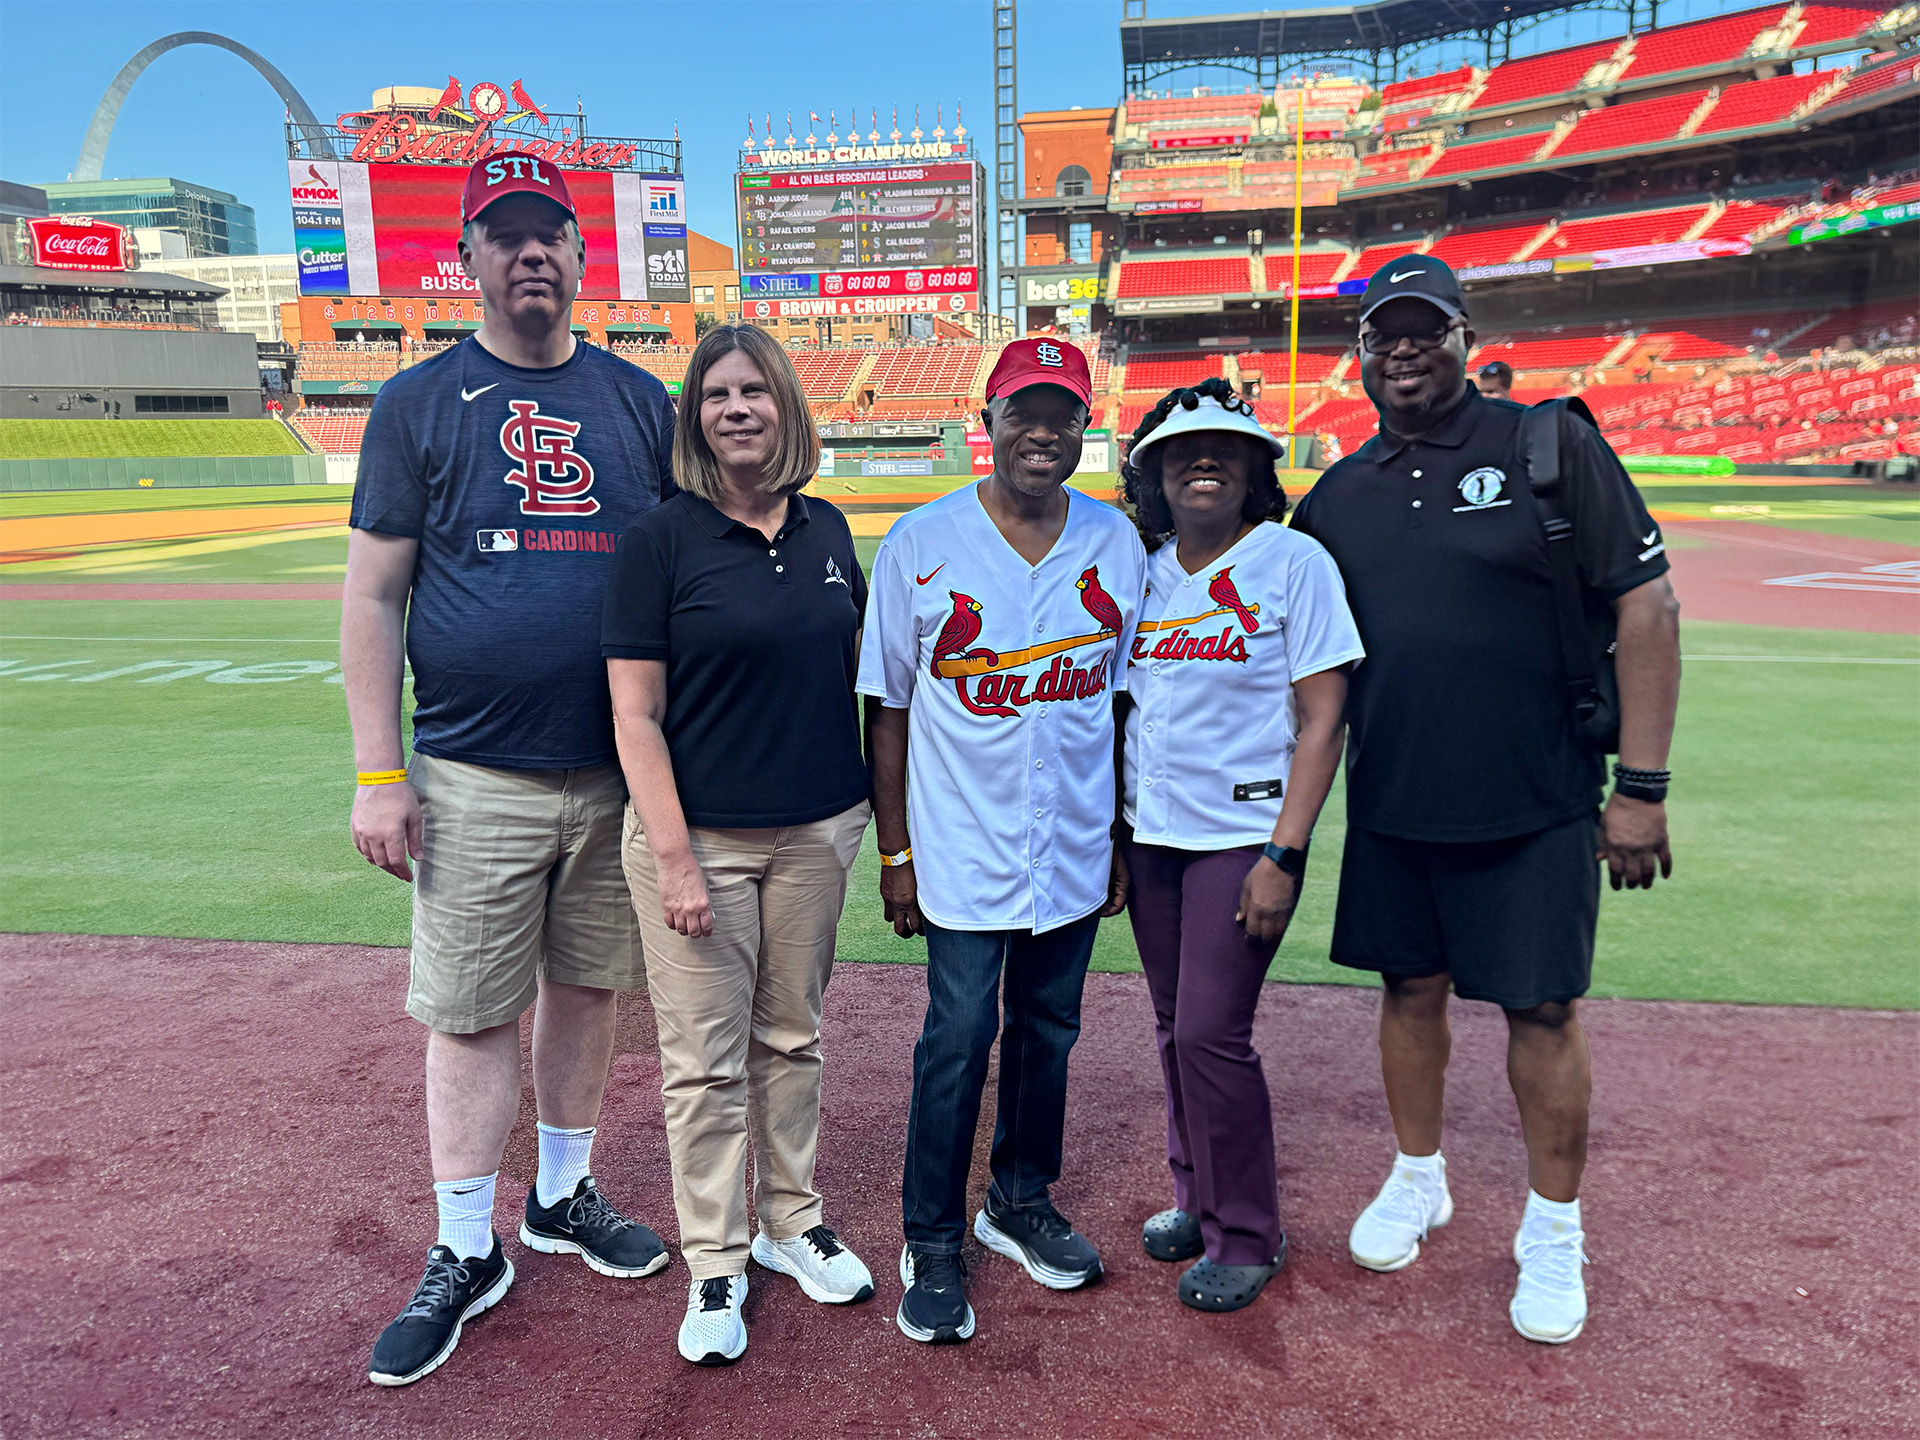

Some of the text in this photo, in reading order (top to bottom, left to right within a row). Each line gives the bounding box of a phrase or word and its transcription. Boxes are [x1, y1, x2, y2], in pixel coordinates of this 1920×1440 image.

[337, 112, 636, 166] Budweiser
[759, 142, 952, 167] WORLD CHAMPIONS
[485, 156, 550, 187] STL
[789, 169, 924, 185] AL ON BASE PERCENTAGE LEADERS
[292, 188, 339, 200] KMOX
[790, 194, 809, 202] JUDGE
[295, 216, 341, 225] 104.1 FM
[746, 212, 751, 220] 2
[746, 228, 752, 236] 3
[45, 234, 111, 256] Coca-Cola
[300, 249, 345, 266] Cutter
[748, 258, 754, 266] 5
[649, 273, 686, 282] TODAY
[759, 276, 803, 292] STIFEL
[367, 306, 377, 319] 2
[385, 306, 395, 319] 6
[405, 306, 415, 320] 9
[424, 306, 438, 320] 10
[448, 306, 463, 321] 14
[779, 296, 938, 316] BROWN & CROUPPEN
[580, 309, 651, 323] 42 45 85
[868, 463, 898, 474] STIFEL
[523, 529, 622, 553] CARDINAL
[1128, 626, 1251, 668] rdinals
